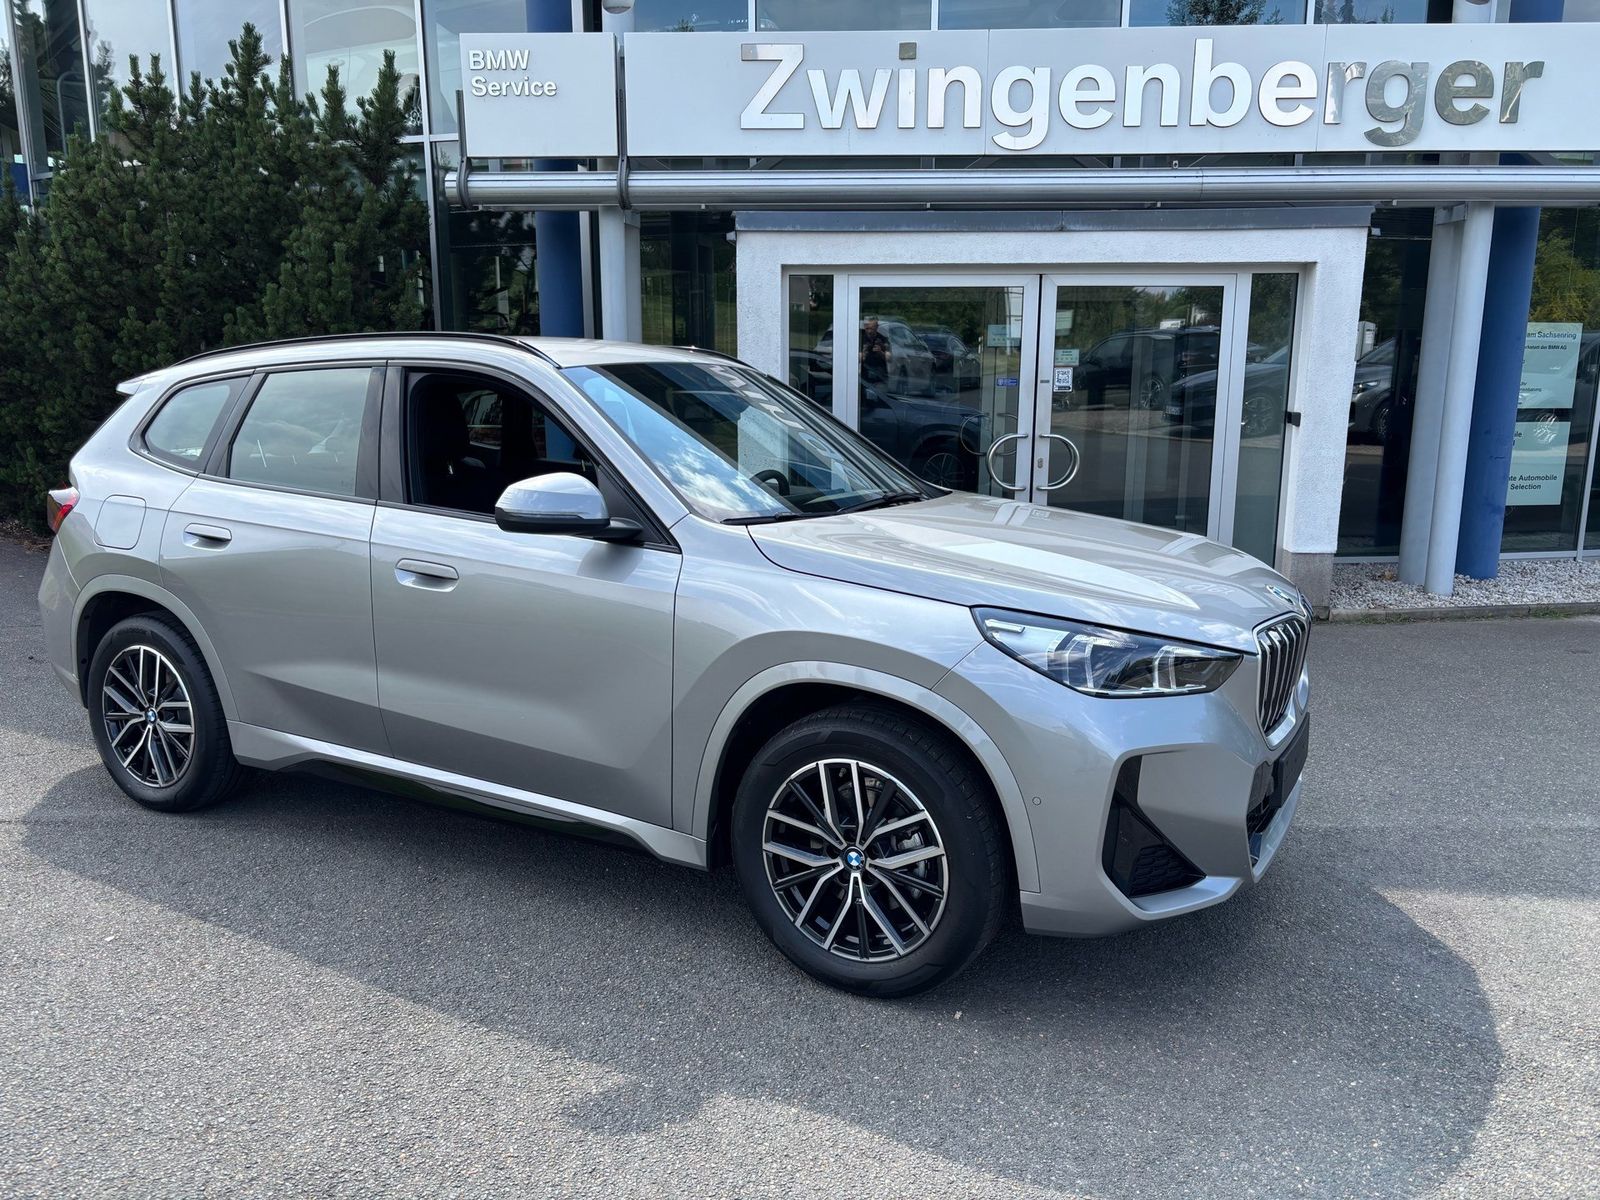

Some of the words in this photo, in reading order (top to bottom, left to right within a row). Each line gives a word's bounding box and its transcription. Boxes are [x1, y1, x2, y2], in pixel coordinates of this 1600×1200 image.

[468, 49, 530, 71] BMW
[471, 75, 558, 97] Service
[740, 38, 1545, 151] Zwingenberger
[1537, 330, 1577, 340] Sachsenring
